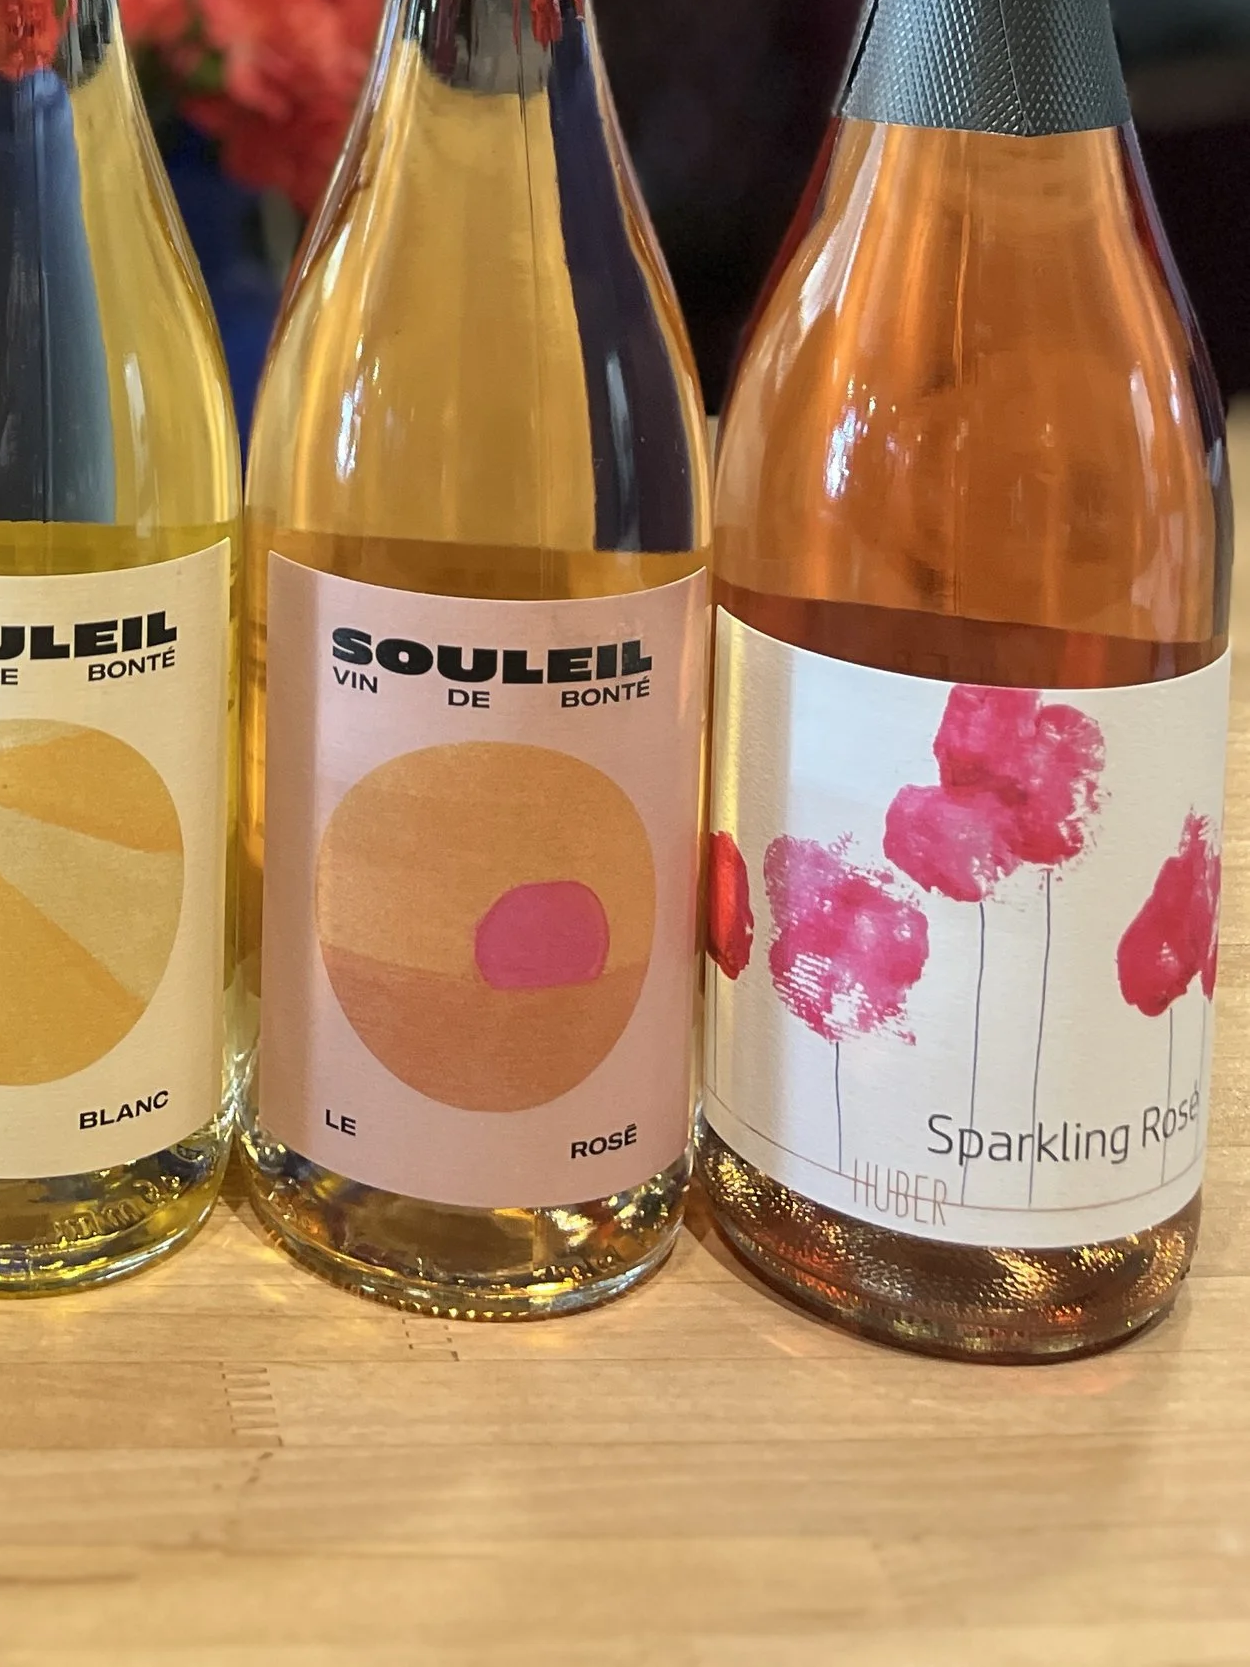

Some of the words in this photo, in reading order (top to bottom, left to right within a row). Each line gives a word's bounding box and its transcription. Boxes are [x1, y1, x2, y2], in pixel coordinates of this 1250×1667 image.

[88, 647, 176, 682] BONTÉ
[332, 627, 653, 684] SOULEIL
[333, 666, 378, 693] VIN
[448, 689, 490, 708] DE
[561, 676, 650, 708] BONTÉ
[79, 1090, 169, 1130] BLANC
[325, 1109, 356, 1137] LE
[570, 1123, 638, 1160] ROSÉ
[927, 1114, 1131, 1167] Sparkling
[853, 1158, 950, 1227] HUBER
